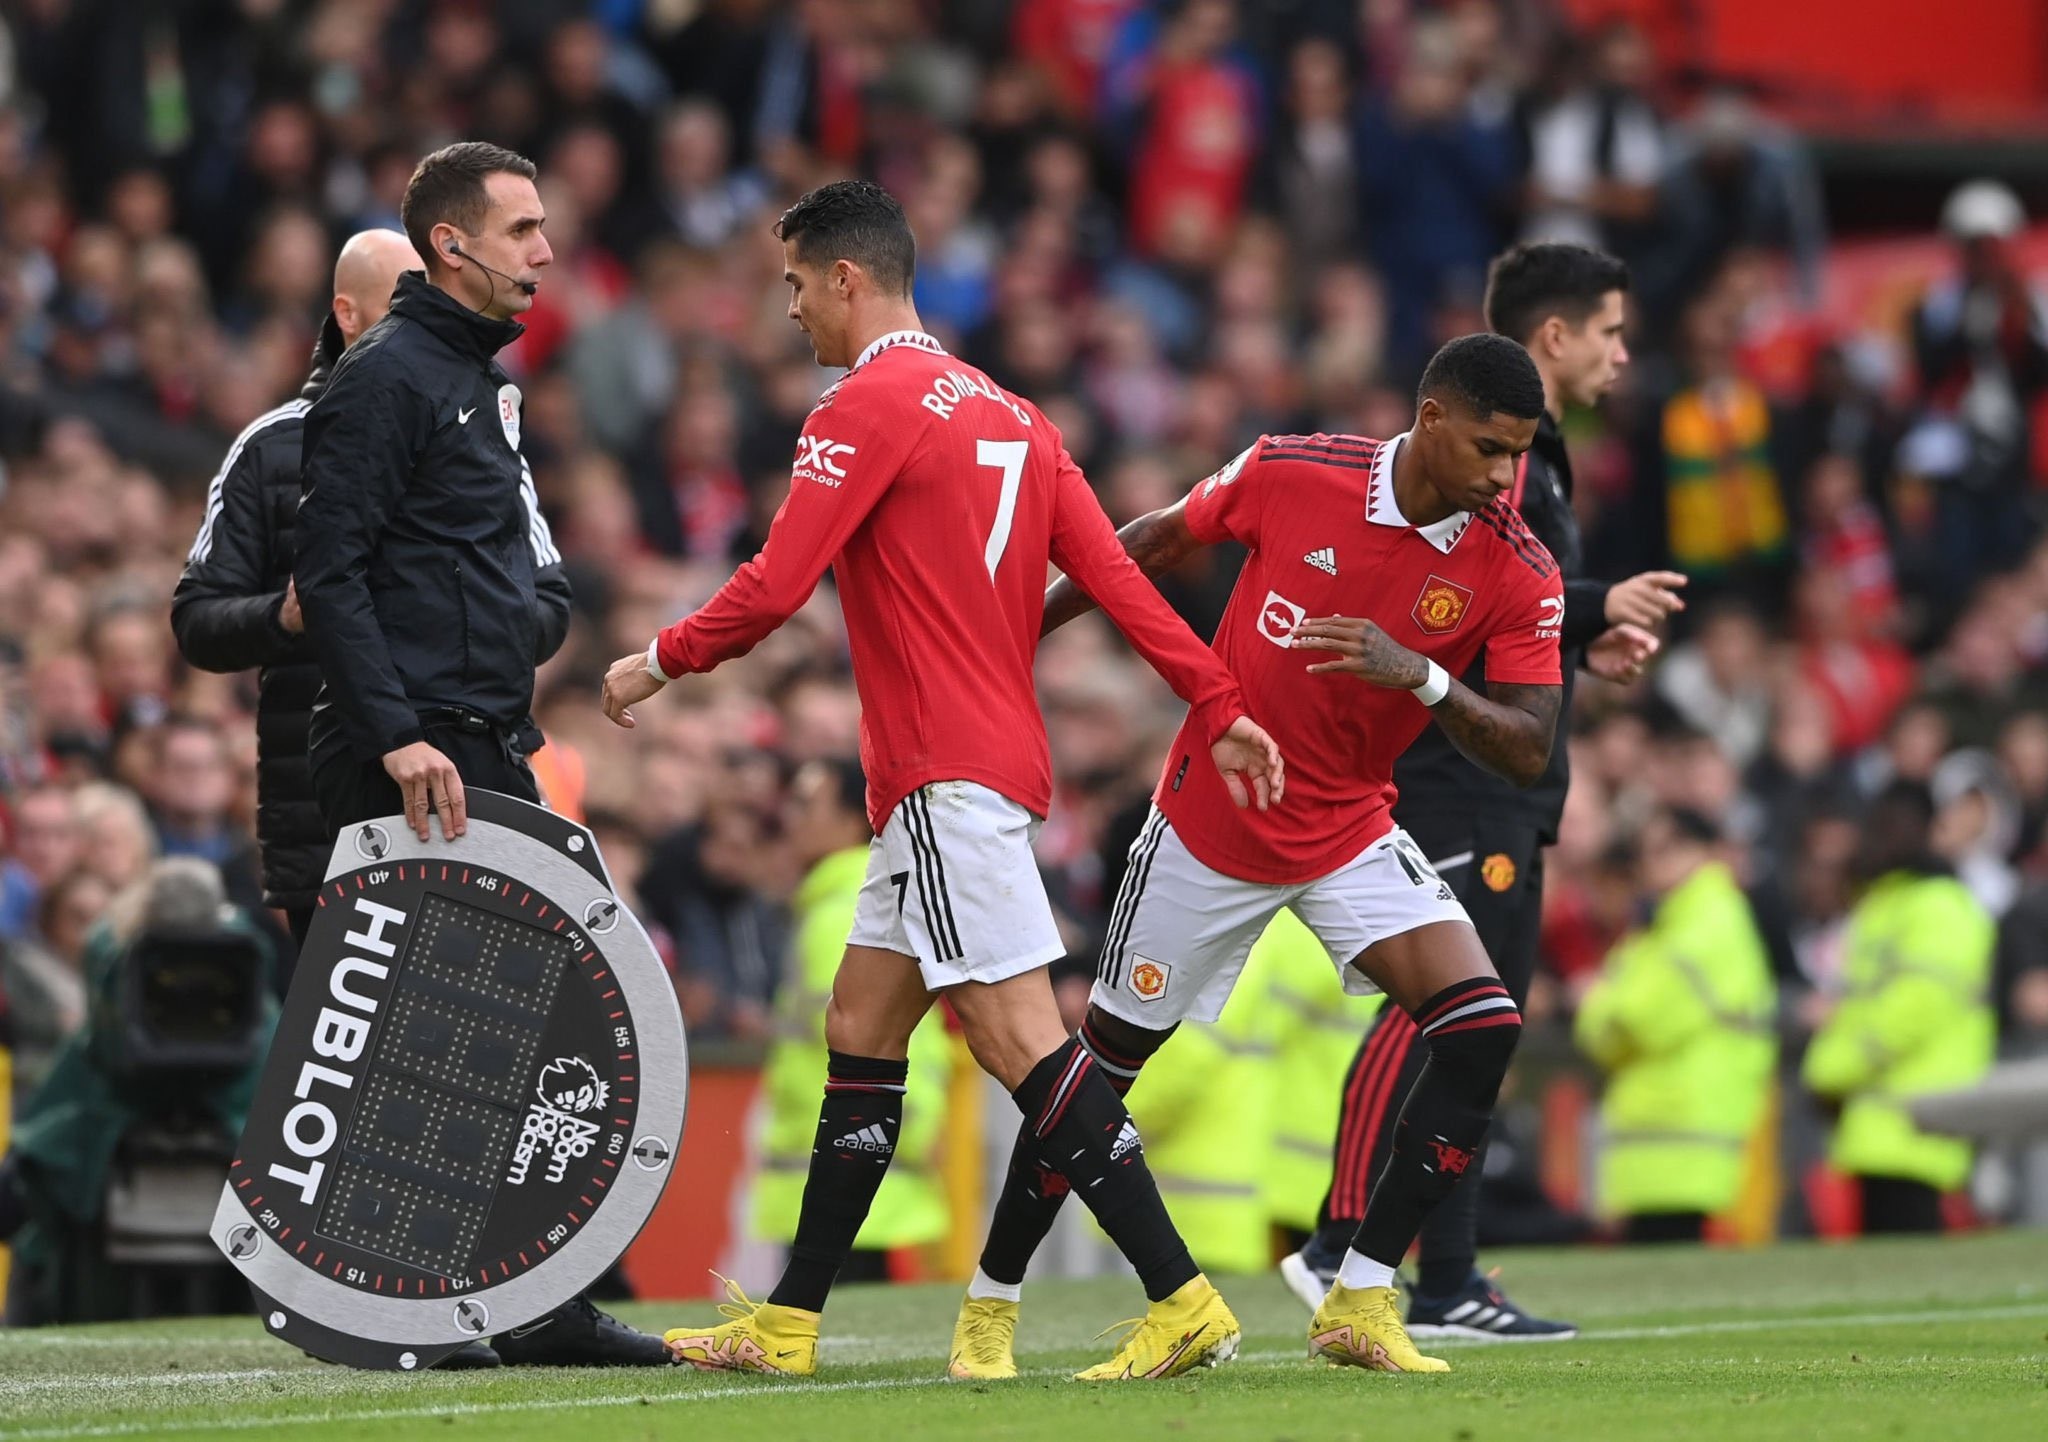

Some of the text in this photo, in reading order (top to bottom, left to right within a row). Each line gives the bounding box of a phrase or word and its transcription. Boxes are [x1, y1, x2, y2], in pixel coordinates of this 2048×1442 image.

[976, 439, 1029, 589] 7
[1303, 554, 1337, 576] adidas
[368, 870, 390, 885] 40
[476, 875, 498, 891] 45
[890, 870, 910, 920] 7
[614, 1026, 630, 1048] 55
[268, 897, 407, 1205] HUBLOT
[571, 1117, 601, 1158] No
[607, 1133, 624, 1155] 60
[833, 1138, 893, 1153] adidas
[1109, 1135, 1142, 1160] adida
[259, 1209, 281, 1230] 20
[547, 1223, 568, 1245] 05
[346, 1267, 367, 1284] 15
